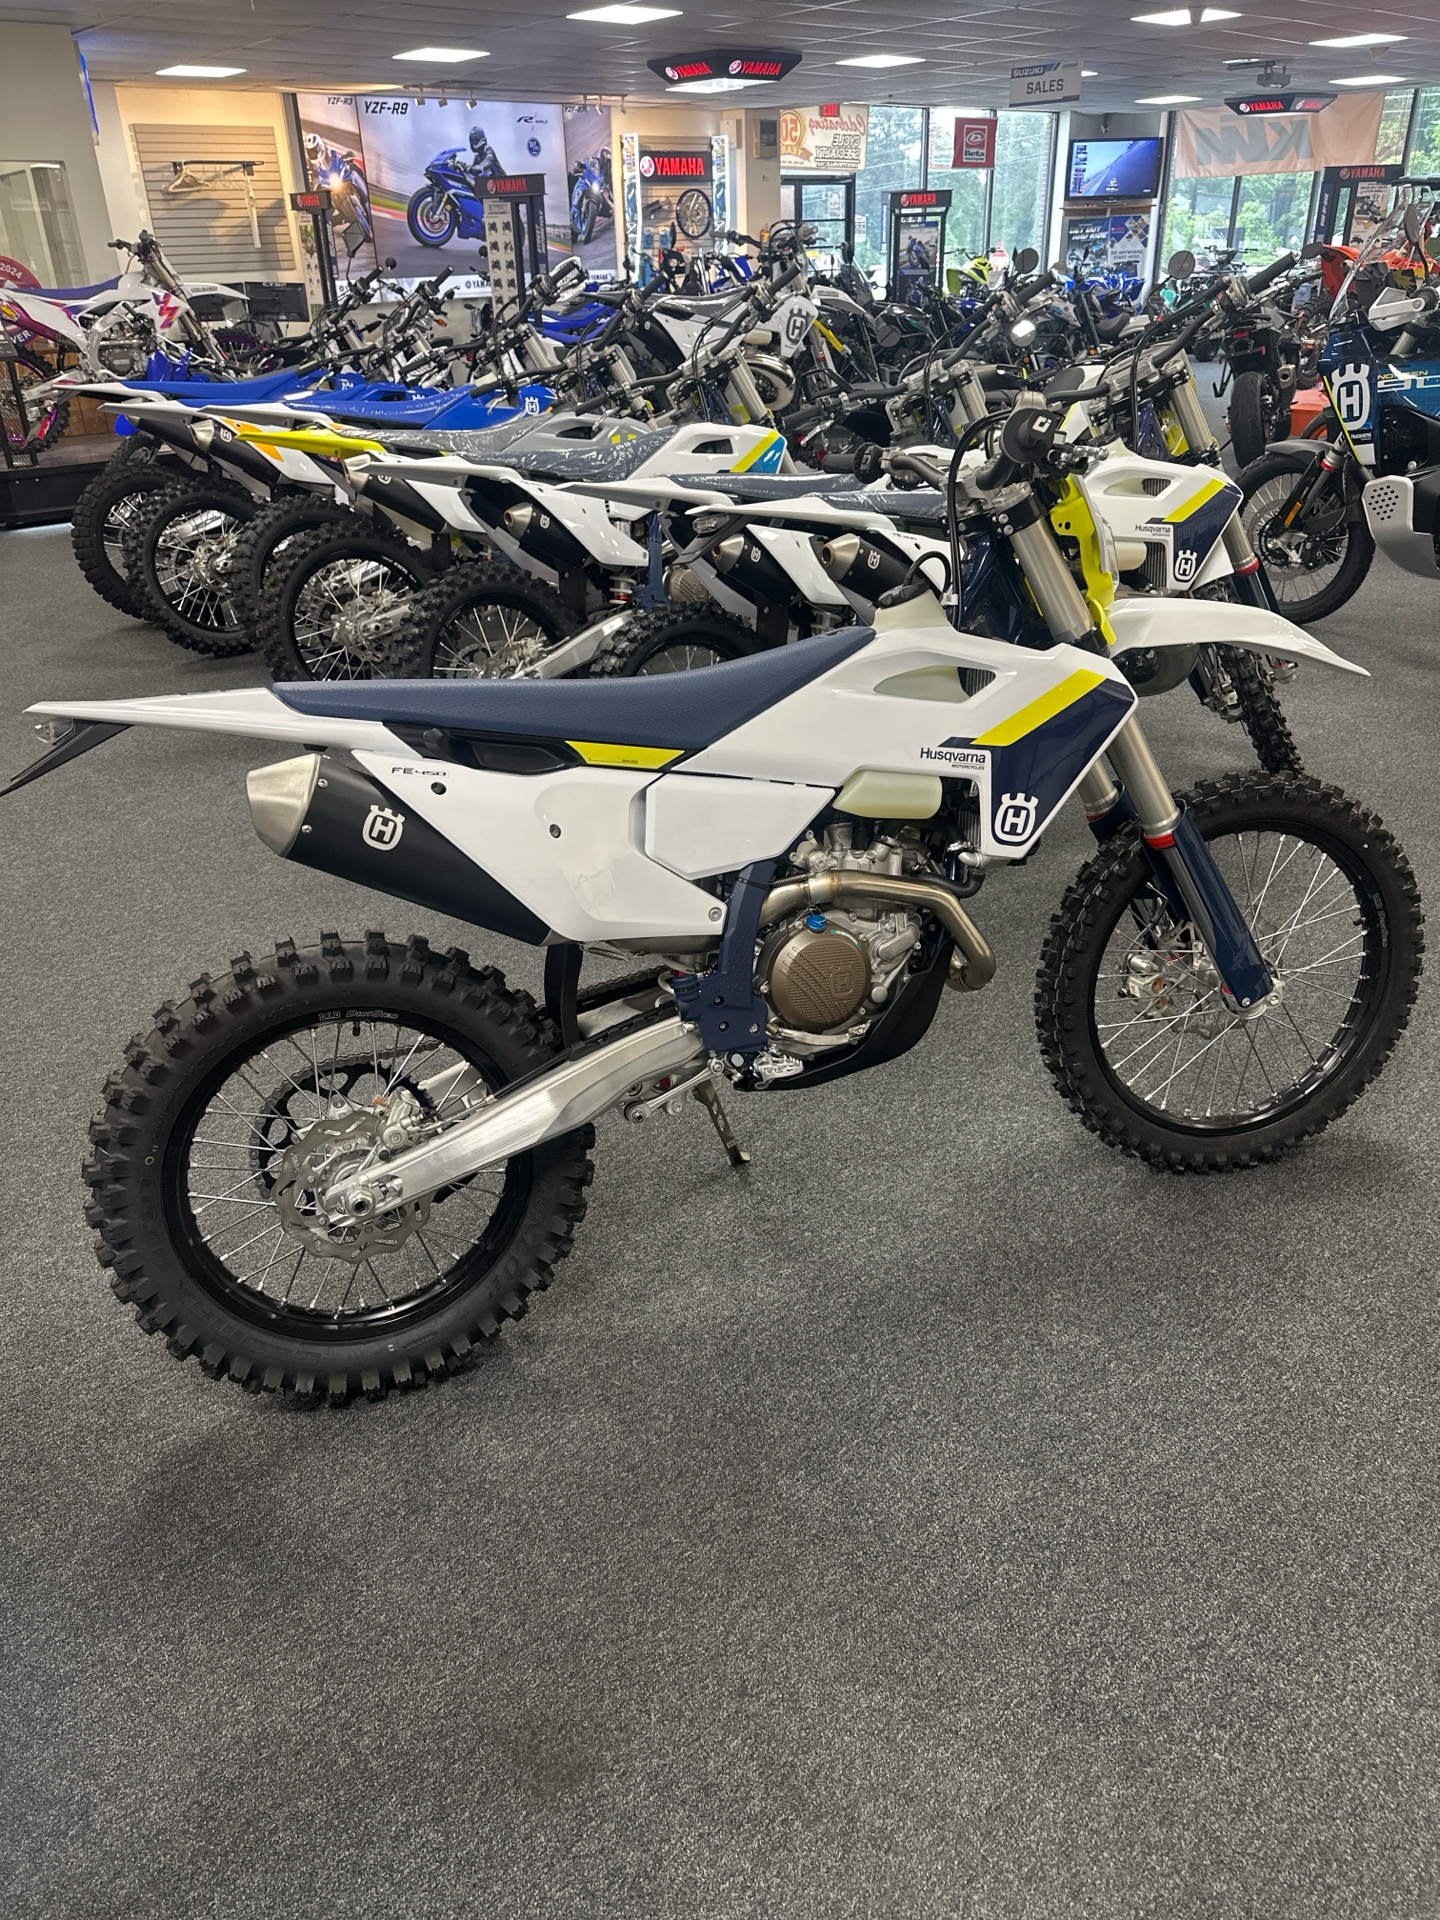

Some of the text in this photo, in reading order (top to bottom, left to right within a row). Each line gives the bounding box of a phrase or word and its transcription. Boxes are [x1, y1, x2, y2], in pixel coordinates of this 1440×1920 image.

[674, 62, 712, 78] YAMAHA
[741, 61, 781, 75] YAMAHA
[1012, 67, 1044, 77] SUZUKI
[1026, 79, 1064, 95] SALES
[364, 101, 409, 115] YZF-R9
[1249, 101, 1284, 111] YAMAHA
[964, 149, 985, 157] Beta
[653, 157, 705, 176] YAMAHA
[1350, 167, 1386, 178] YAMAHA
[496, 178, 527, 192] YAMAHA
[909, 193, 936, 205] YAMAHA
[0, 262, 23, 279] 2024
[1377, 370, 1428, 380] NOEN
[1135, 524, 1171, 535] Husqvarna
[920, 747, 986, 763] Husqvarna
[951, 763, 985, 771] MOTORCYCLES
[487, 1168, 554, 1302] DUNLOP
